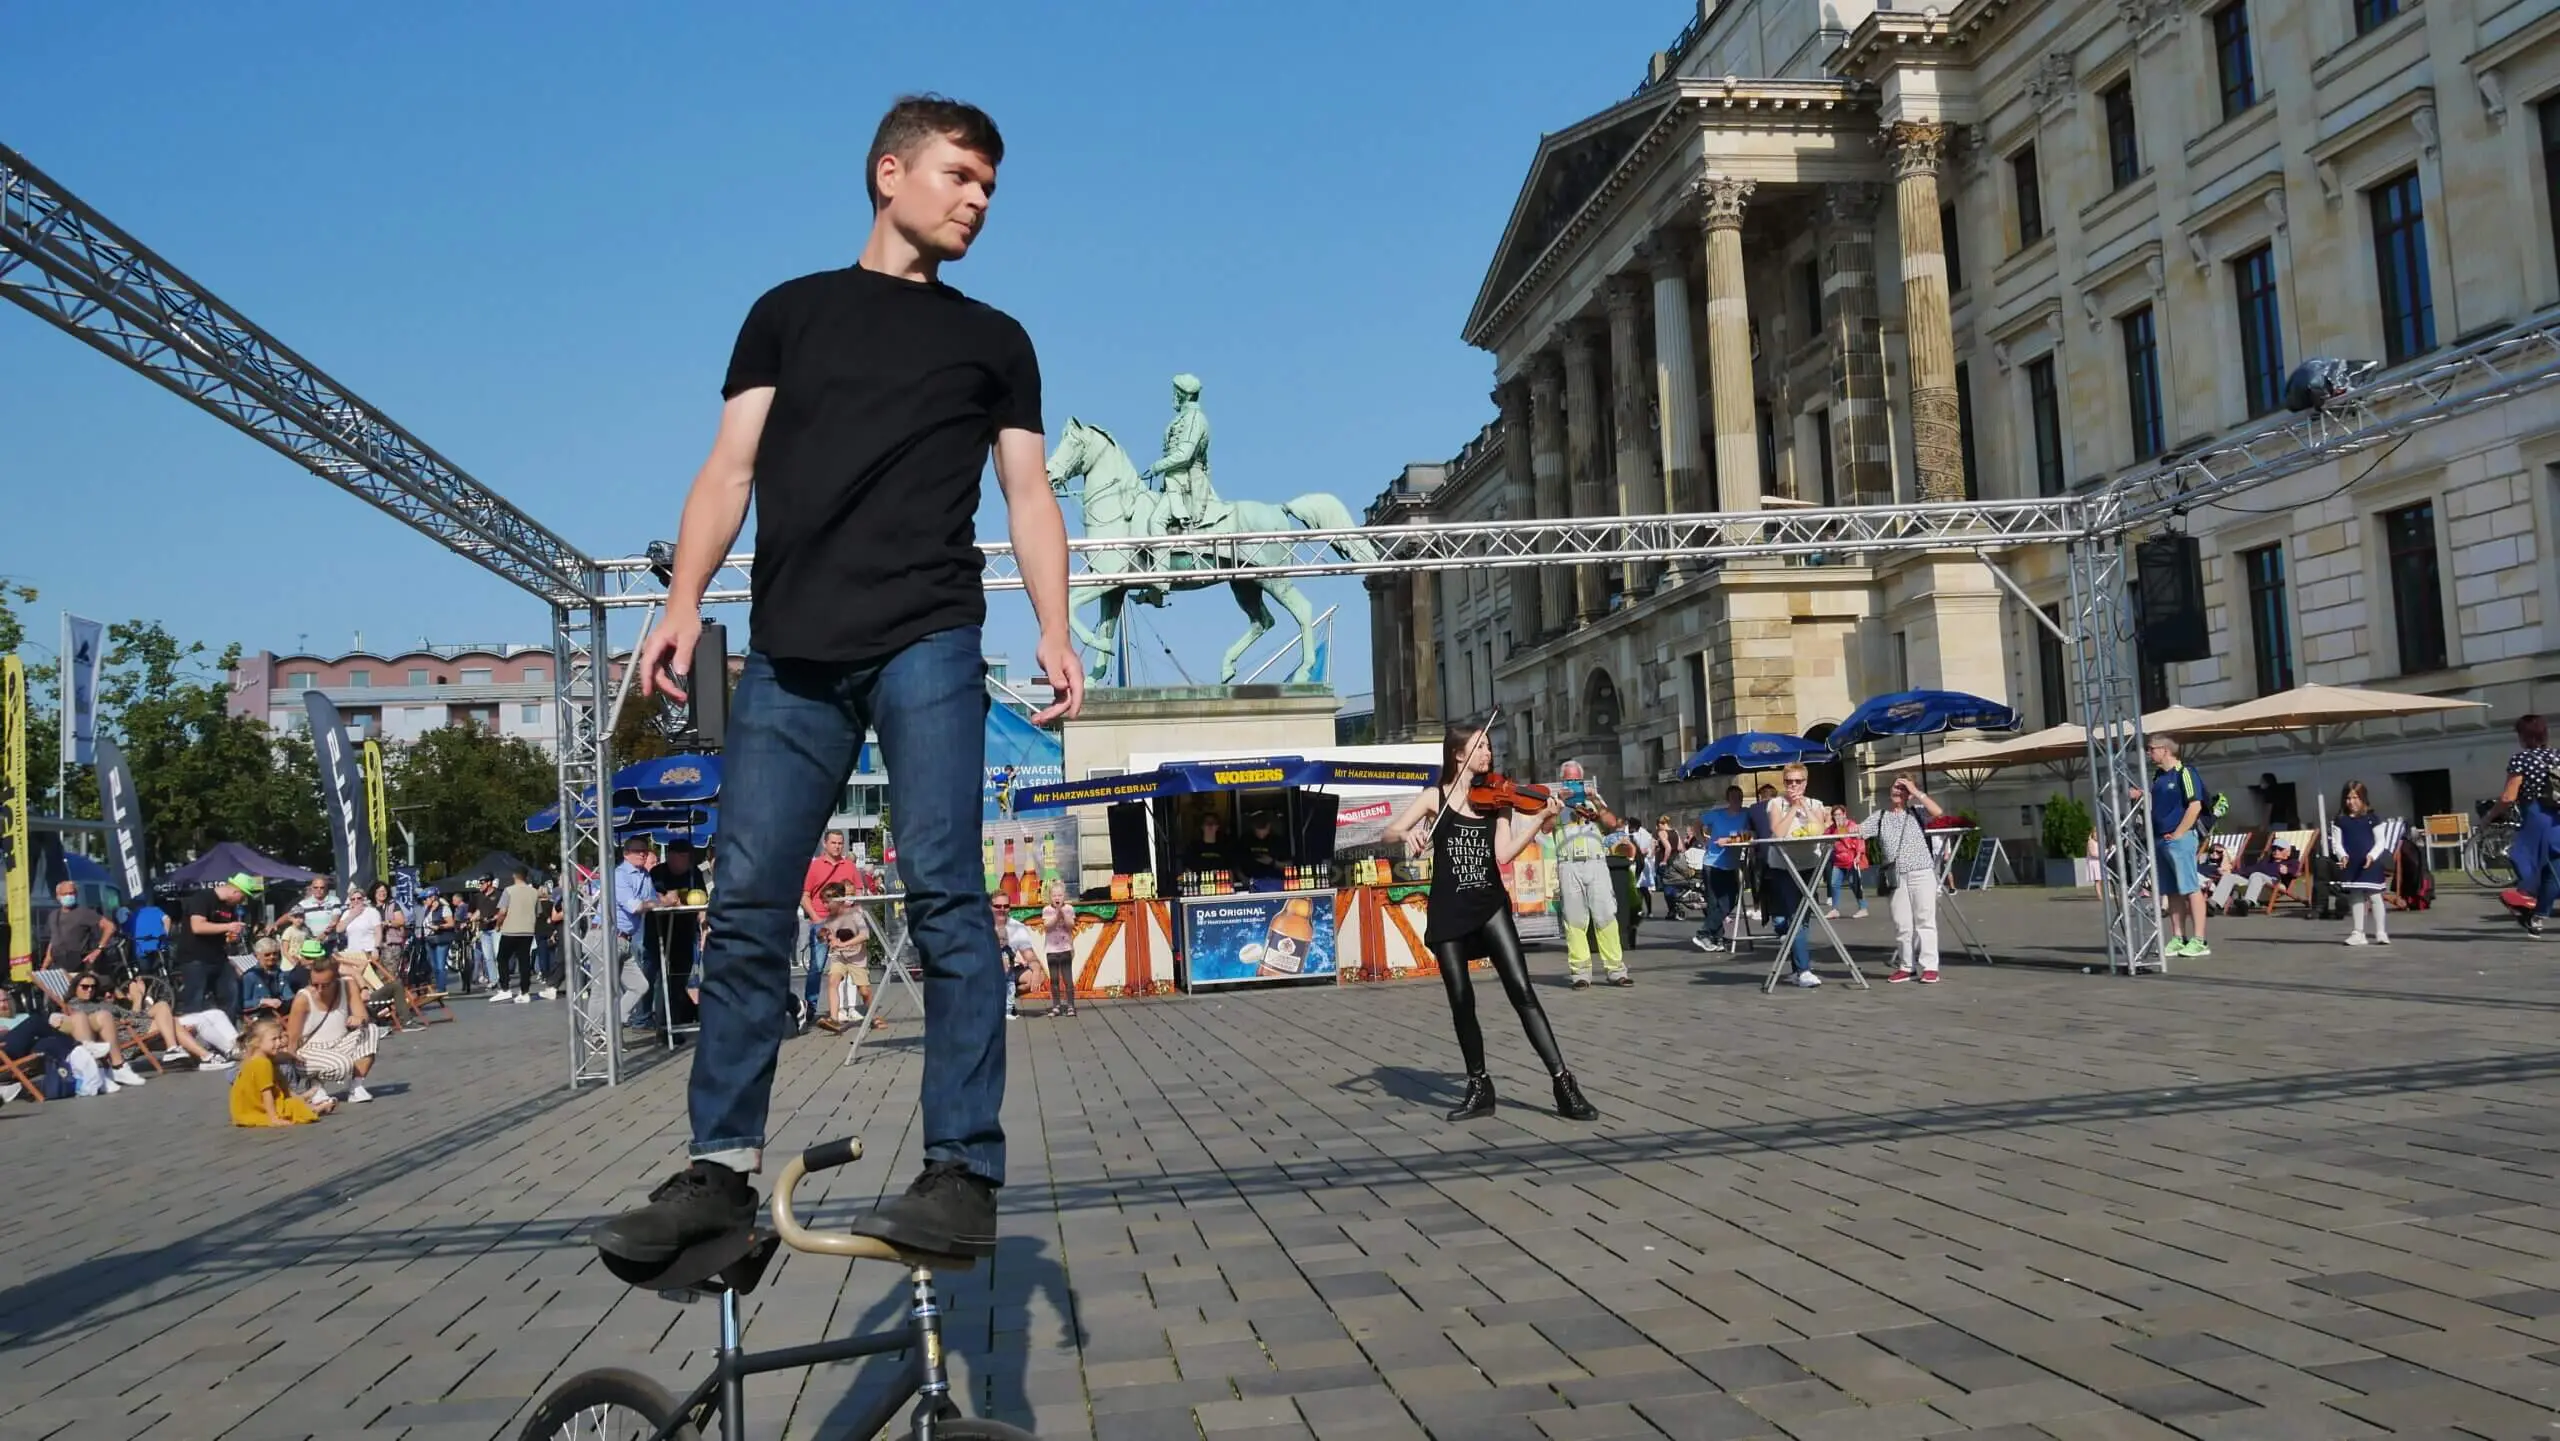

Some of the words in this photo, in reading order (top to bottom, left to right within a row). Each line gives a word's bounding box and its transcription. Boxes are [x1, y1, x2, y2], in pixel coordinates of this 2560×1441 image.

[985, 765, 1062, 776] VOSWAGEN
[1348, 768, 1397, 779] HARZWASSER
[1397, 770, 1429, 780] GEBRAUT
[1214, 768, 1285, 785] WOLTERS
[1033, 793, 1050, 803] MIT
[1052, 788, 1113, 801] HARZWASSER
[1114, 783, 1159, 795] GEBRAUT
[1460, 828, 1479, 838] DO
[1447, 837, 1488, 848] SMALL
[1446, 846, 1491, 858] THINGS
[1452, 855, 1483, 866] WITH
[1458, 872, 1486, 883] LOVE
[1196, 910, 1217, 918] DAS
[1219, 907, 1266, 917] ORIGINAL
